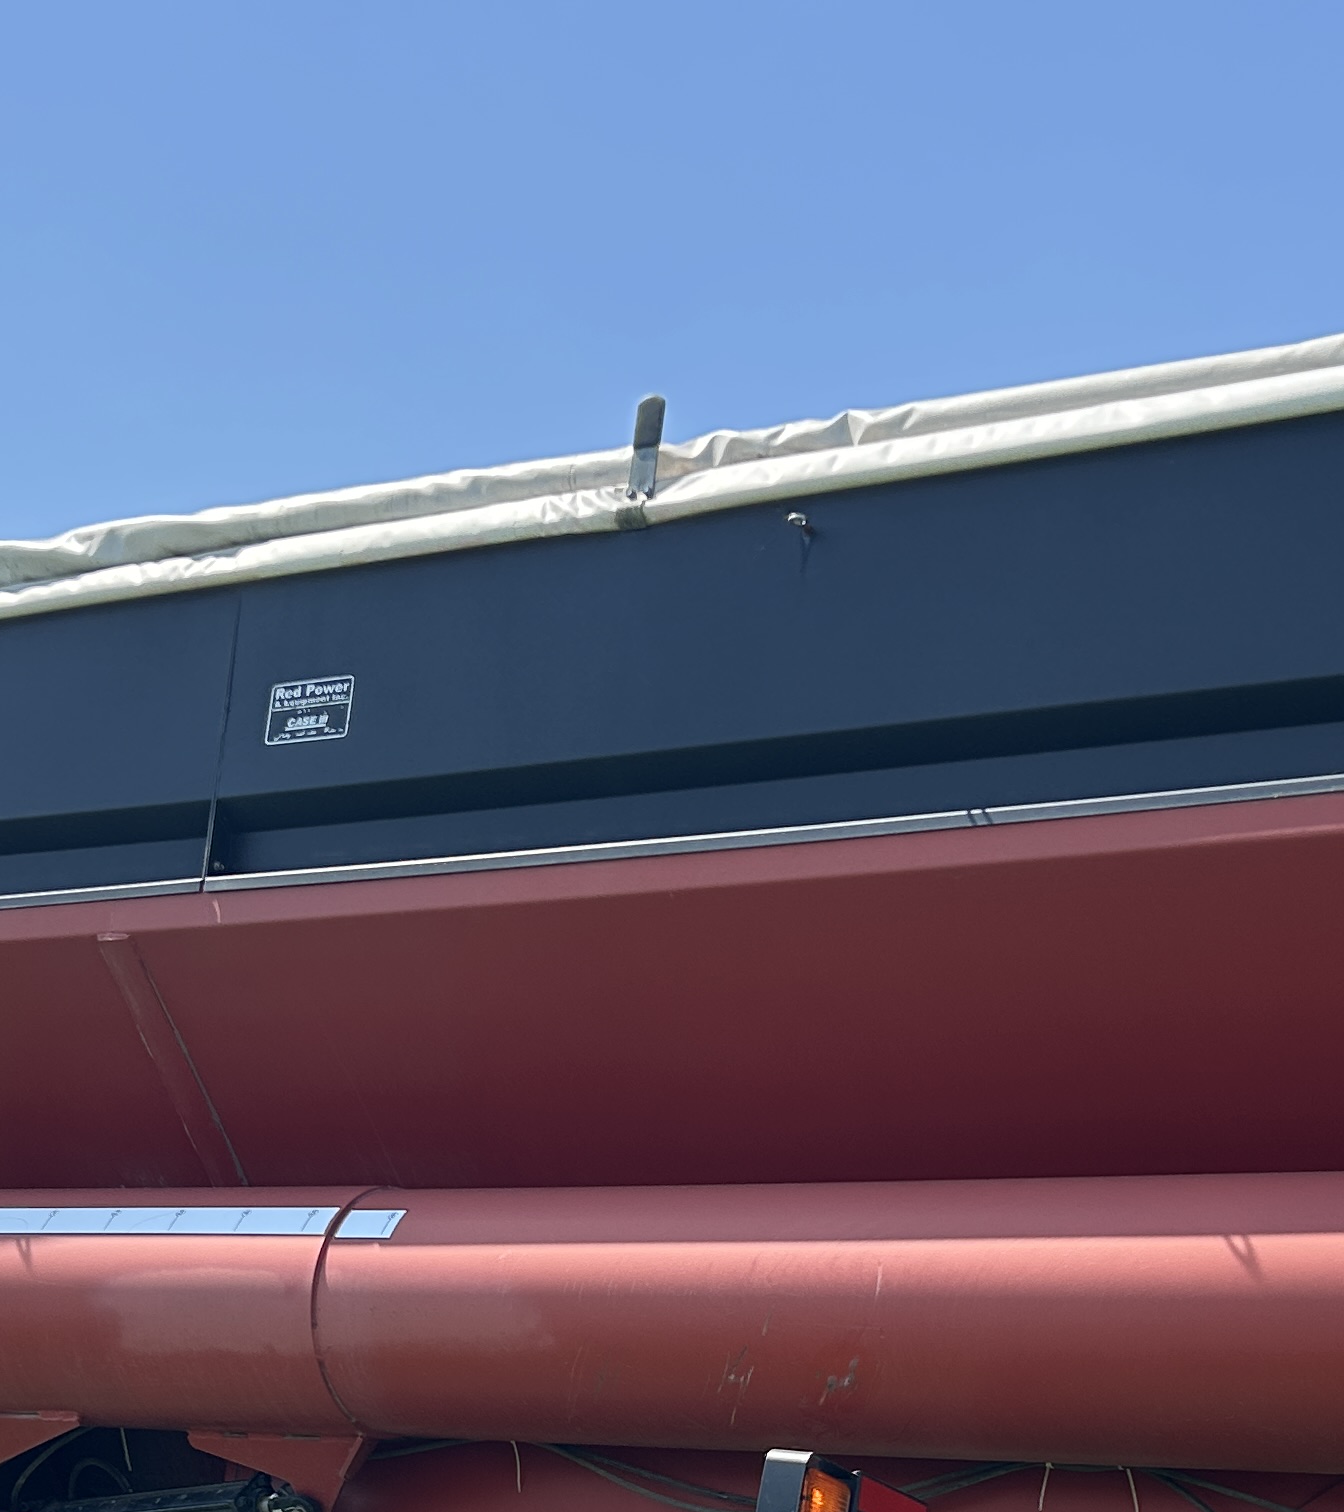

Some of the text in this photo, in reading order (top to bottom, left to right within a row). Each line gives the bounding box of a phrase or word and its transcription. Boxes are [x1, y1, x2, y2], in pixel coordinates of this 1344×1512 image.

[275, 682, 350, 700] Red Power
[287, 716, 318, 728] CASE
